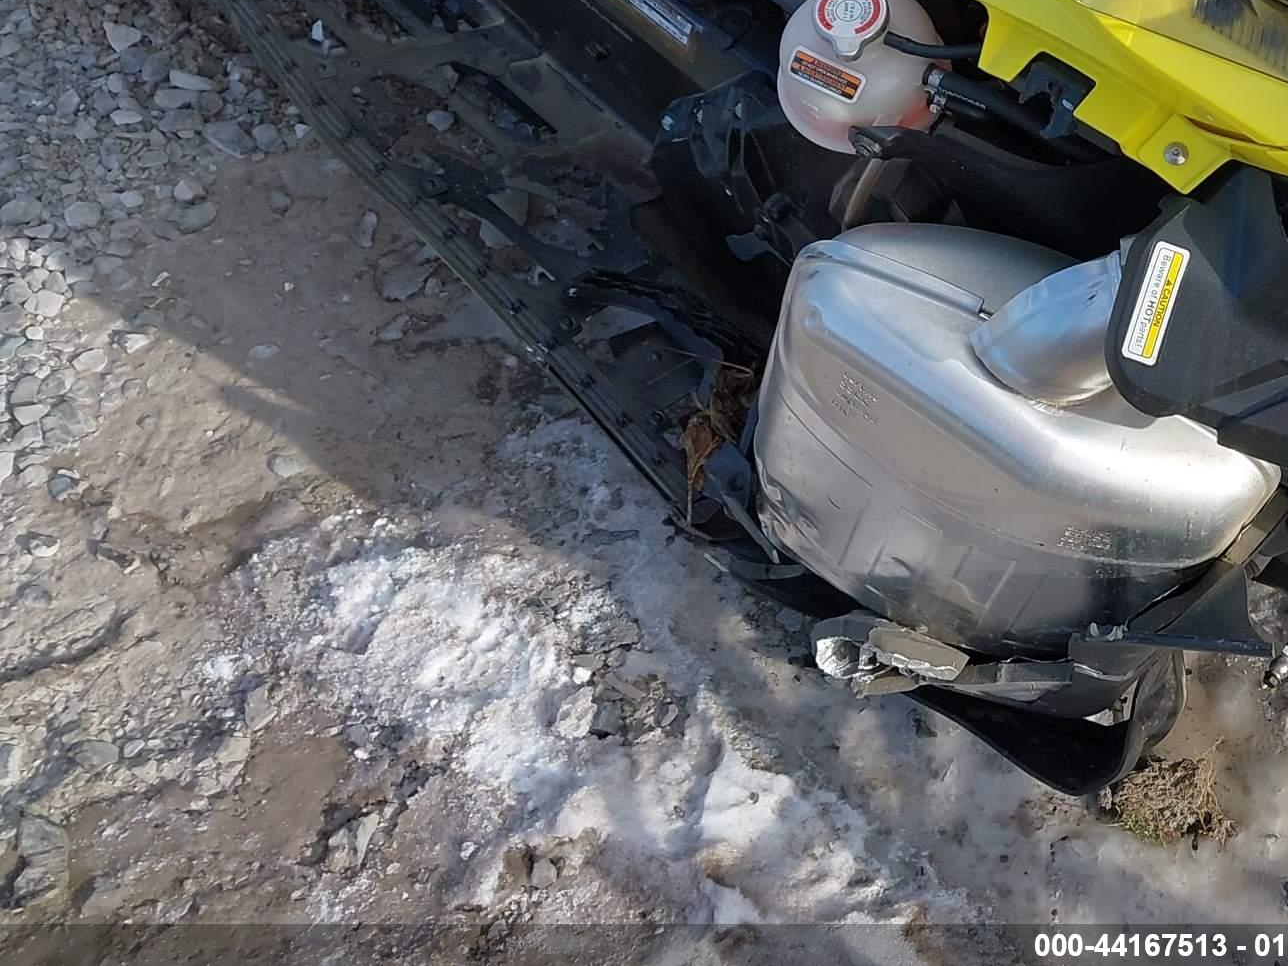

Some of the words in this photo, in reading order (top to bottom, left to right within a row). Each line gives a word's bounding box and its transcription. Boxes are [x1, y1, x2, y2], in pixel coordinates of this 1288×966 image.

[1154, 255, 1171, 288] Beware
[1150, 289, 1158, 299] of
[1145, 299, 1156, 324] HOT
[1153, 288, 1171, 328] CAUTION
[1134, 322, 1148, 348] parts!
